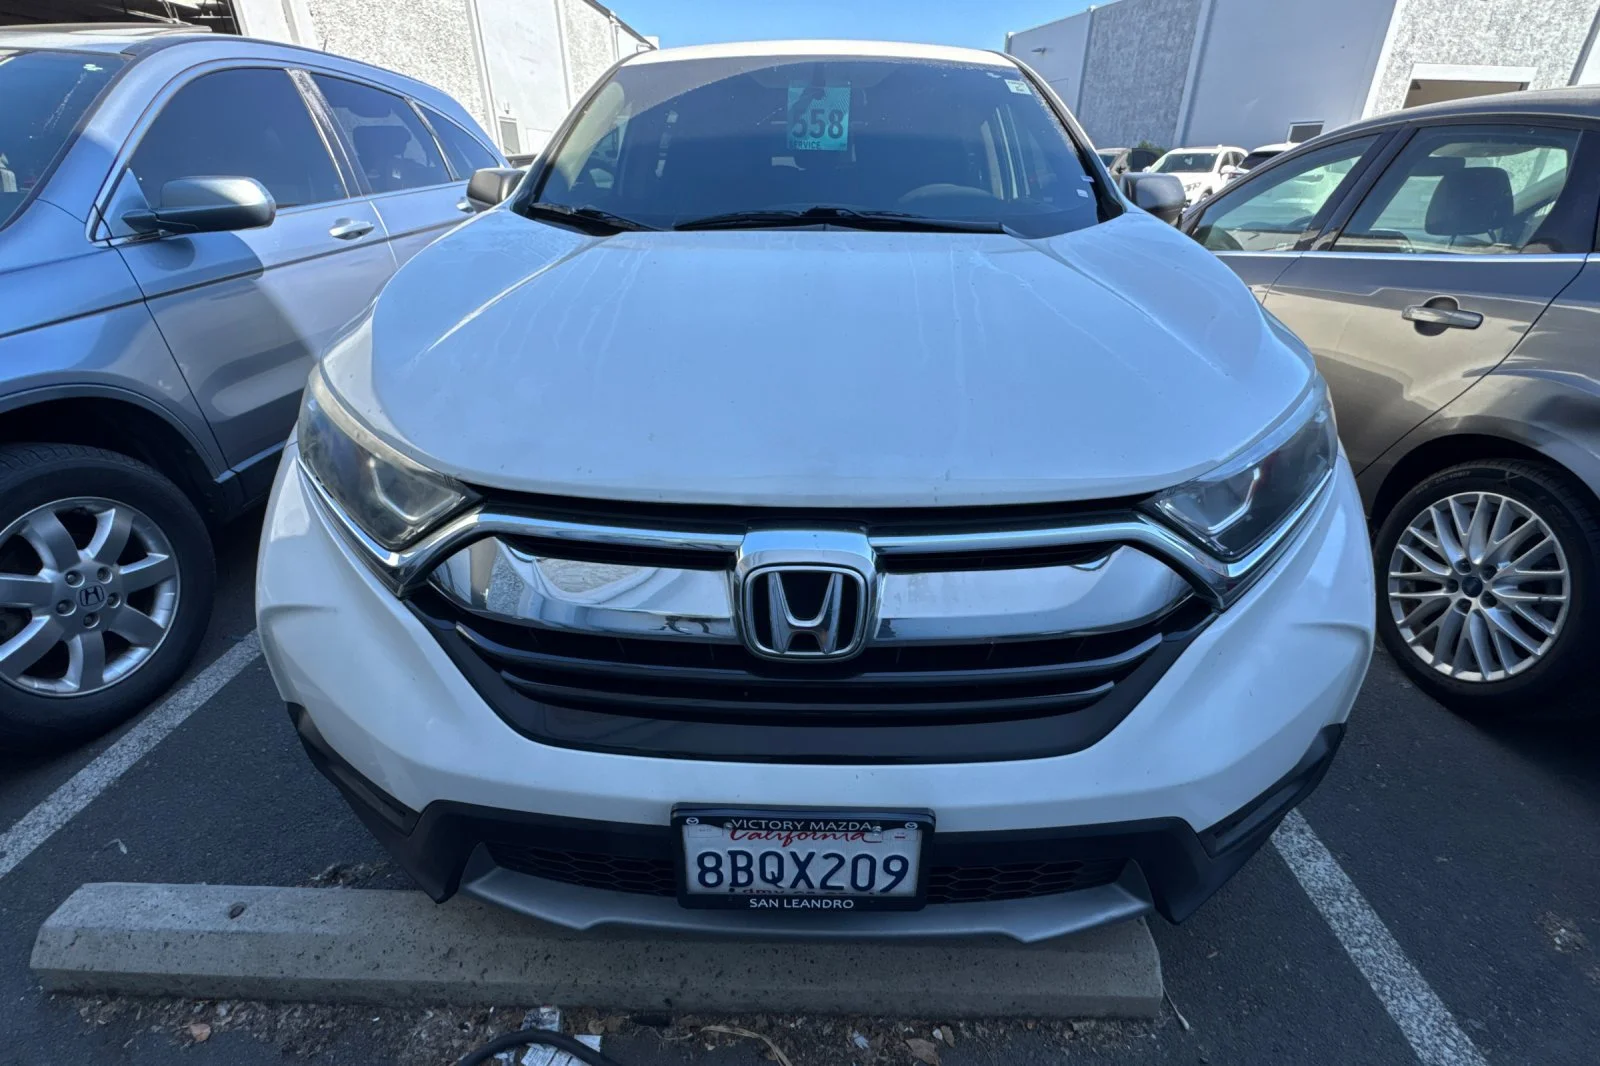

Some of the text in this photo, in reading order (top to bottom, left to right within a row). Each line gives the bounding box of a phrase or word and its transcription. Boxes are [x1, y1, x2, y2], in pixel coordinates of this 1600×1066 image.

[731, 819, 873, 832] VICTORY MAZDA
[696, 850, 909, 893] 8BQX209
[749, 898, 854, 909] SAN LEANDRO
